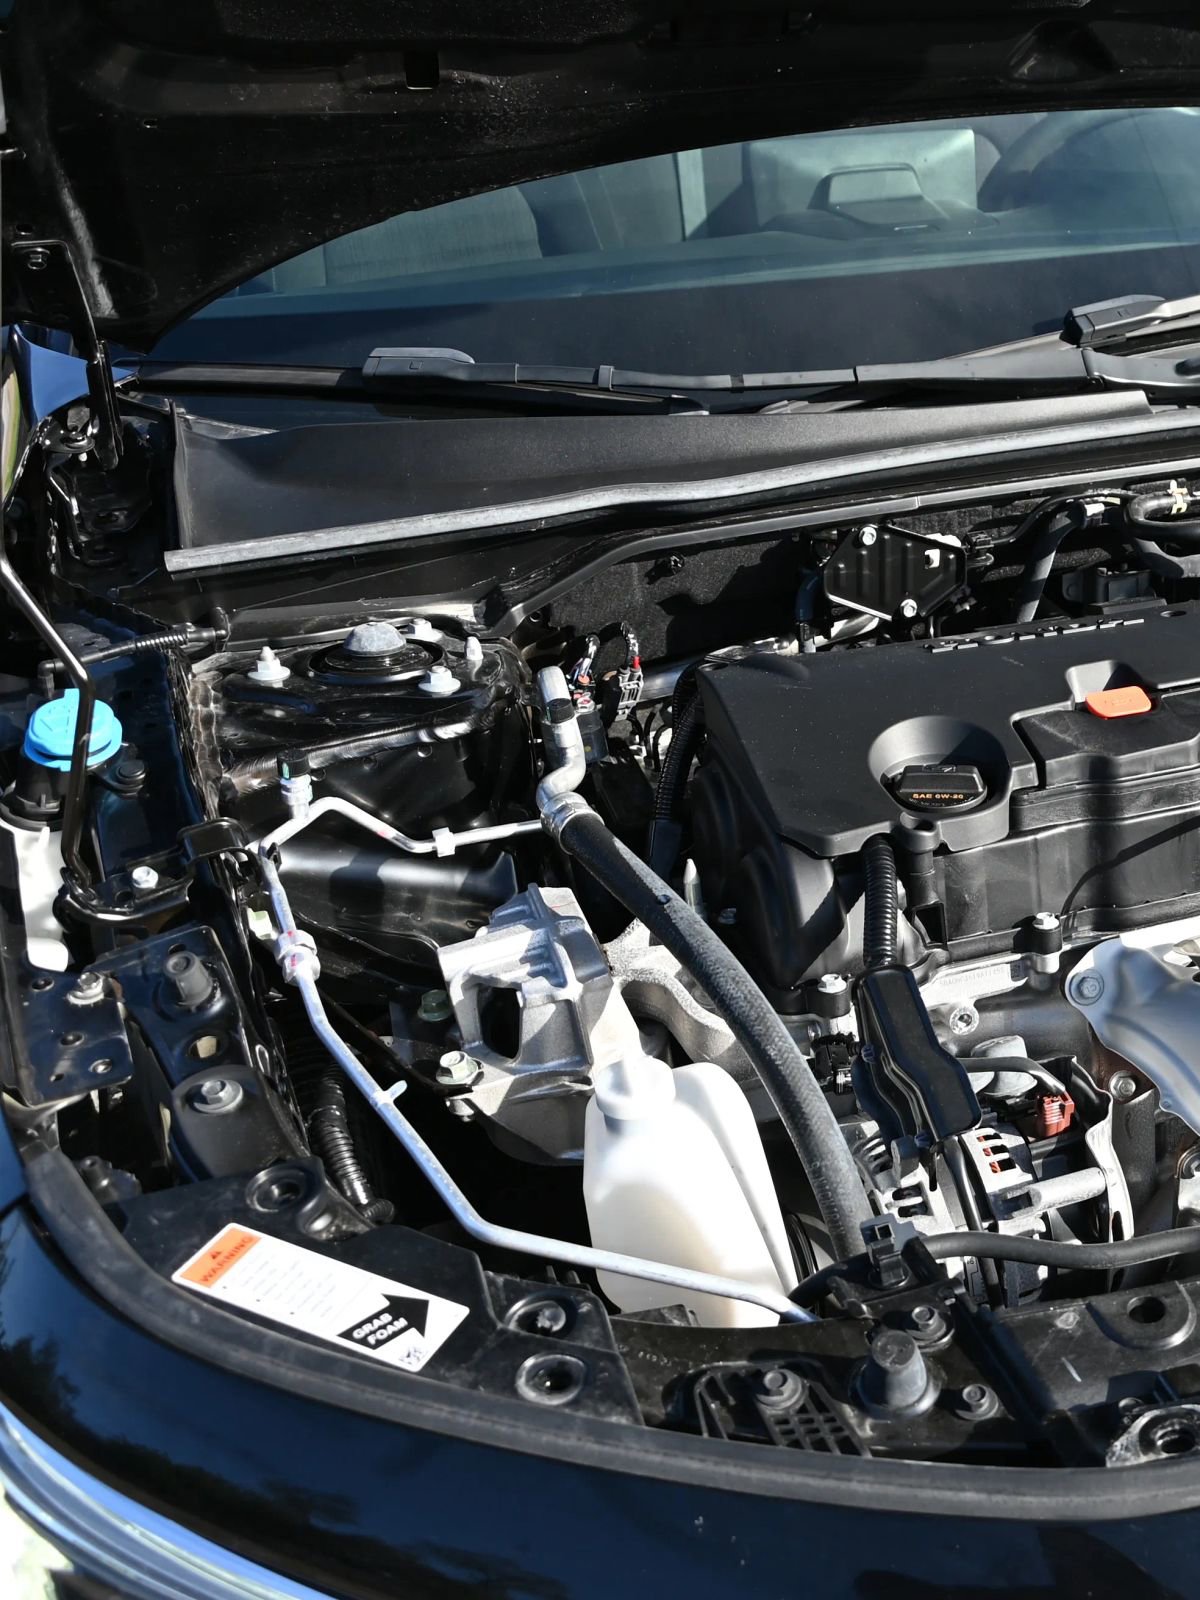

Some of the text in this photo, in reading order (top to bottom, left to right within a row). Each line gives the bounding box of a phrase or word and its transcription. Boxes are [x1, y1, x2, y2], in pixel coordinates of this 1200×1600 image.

[200, 1235, 255, 1282] WARNING
[352, 1312, 393, 1339] GRAB
[366, 1317, 409, 1346] FOAM
